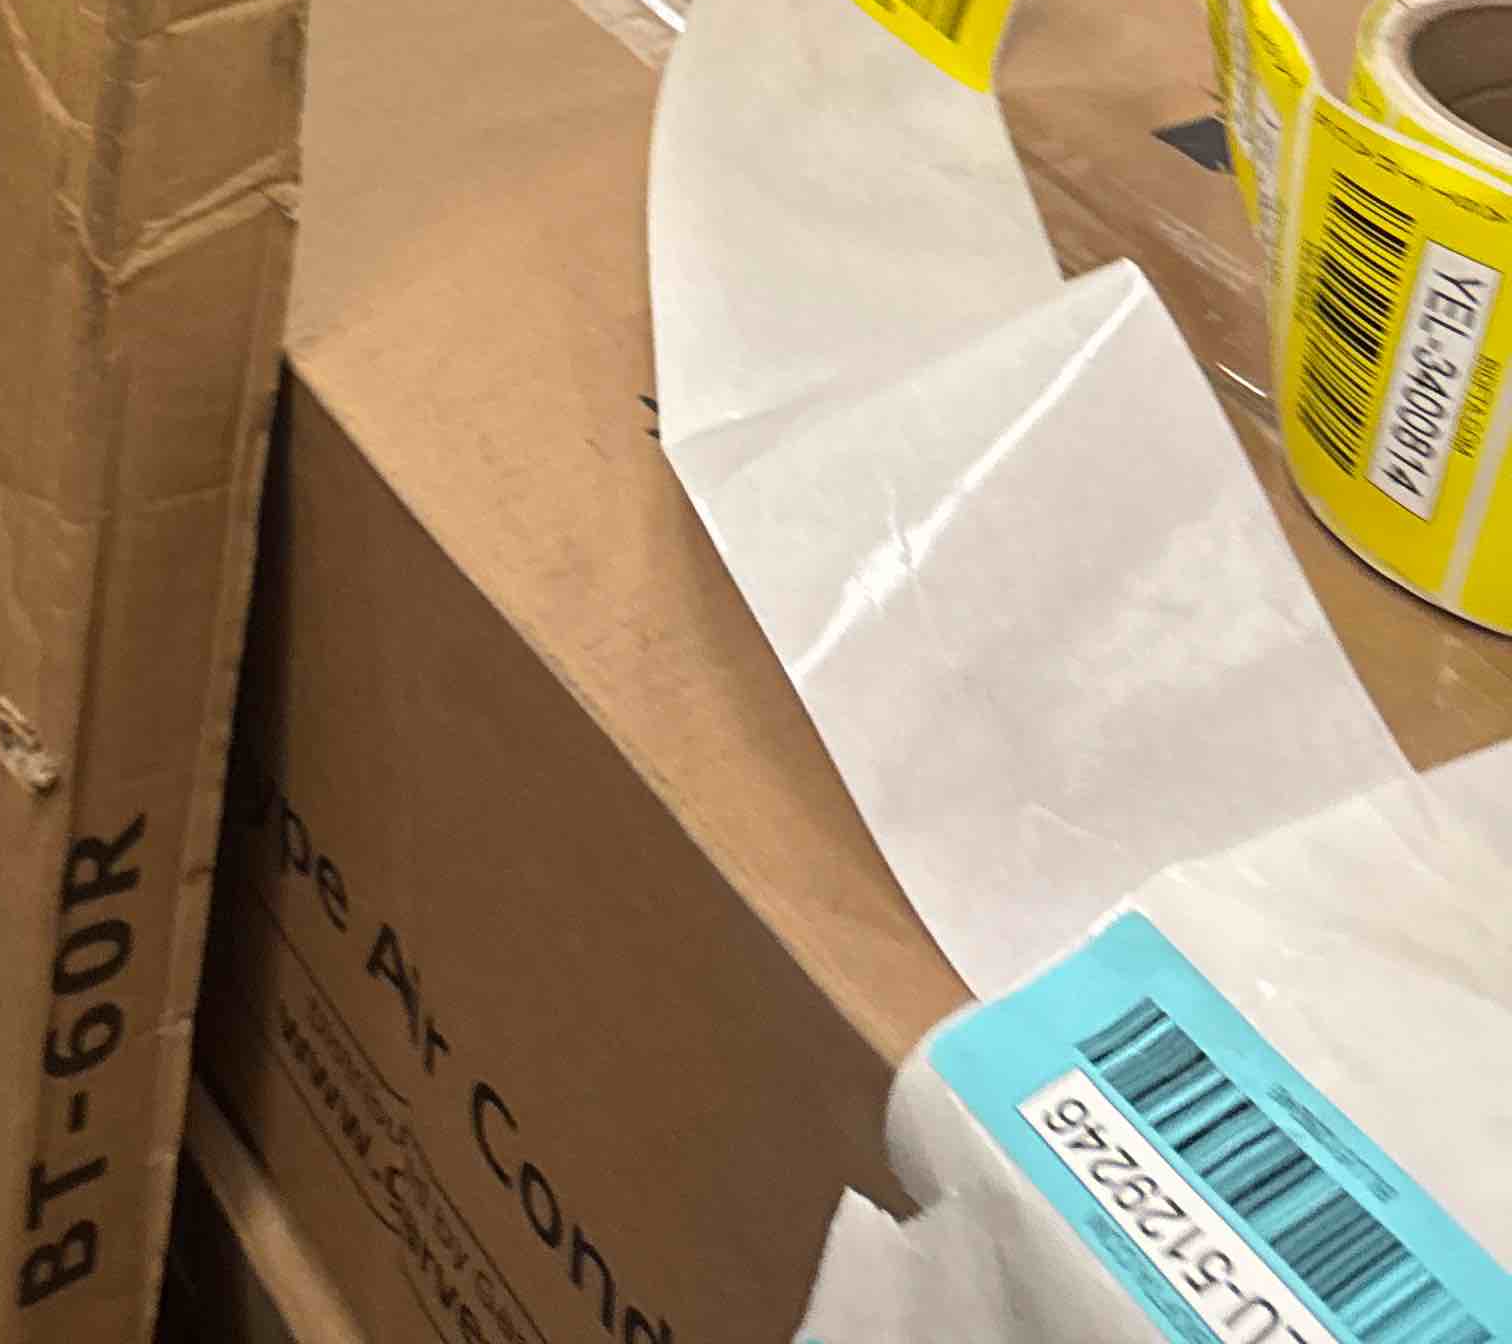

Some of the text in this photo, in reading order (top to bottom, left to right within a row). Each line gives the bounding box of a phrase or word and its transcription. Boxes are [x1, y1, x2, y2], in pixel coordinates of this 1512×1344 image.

[1381, 267, 1484, 498] YEL-3400814
[16, 812, 147, 1310] BT-60R
[1041, 1095, 1311, 1344] U-5129246
